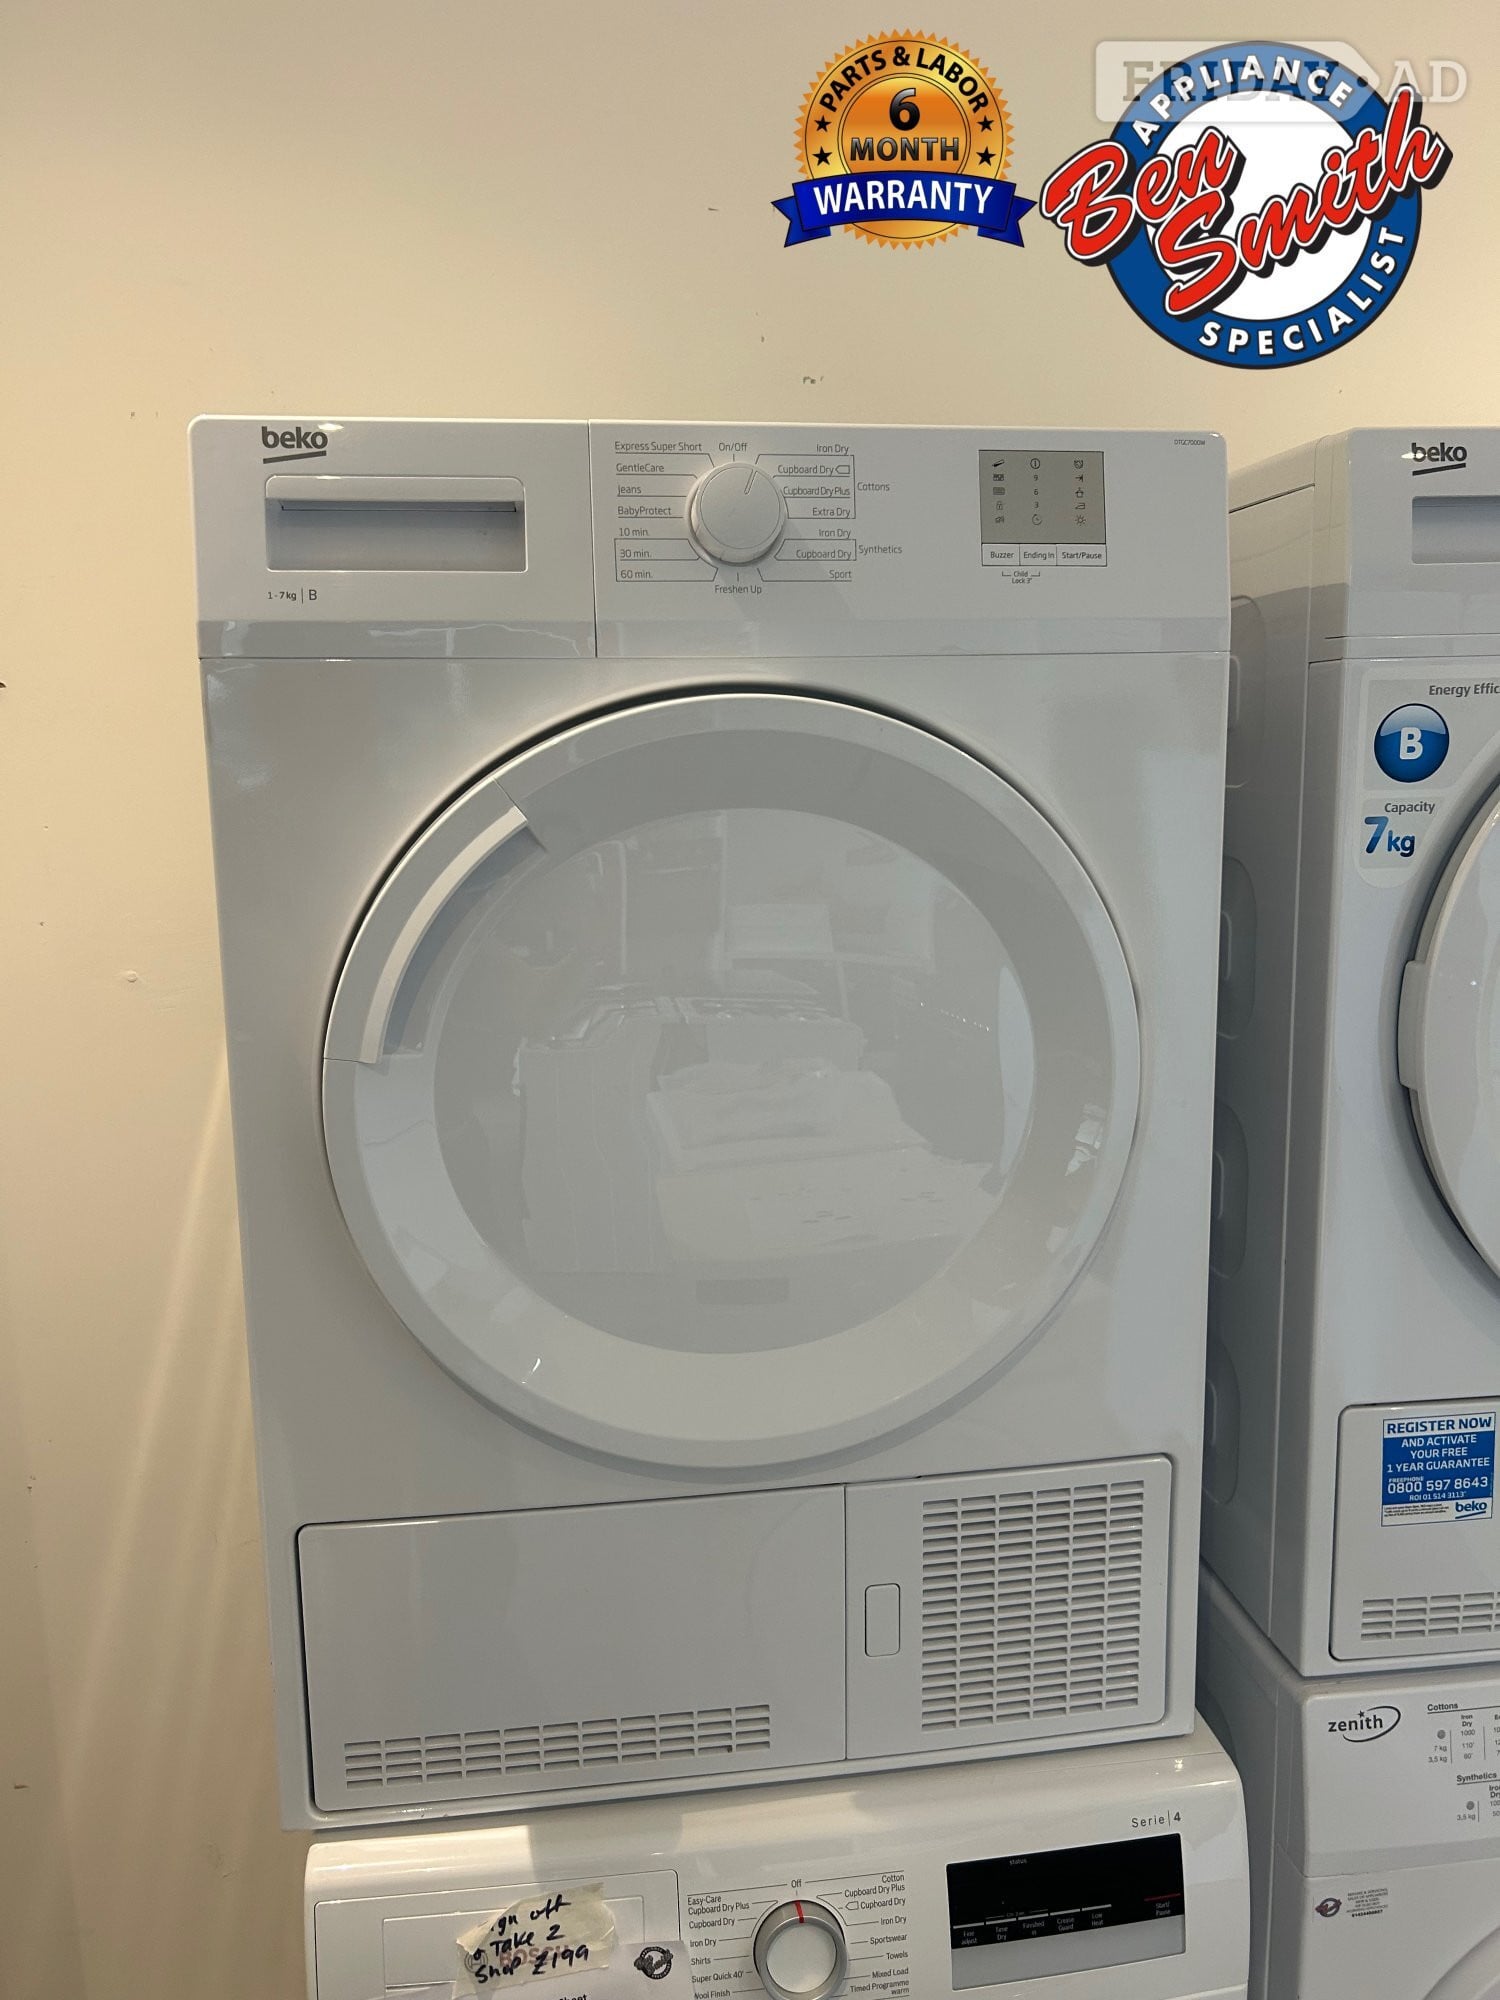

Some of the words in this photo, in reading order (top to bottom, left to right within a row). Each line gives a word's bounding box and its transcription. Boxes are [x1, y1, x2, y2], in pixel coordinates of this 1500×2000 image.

[262, 426, 328, 449] beko
[615, 441, 648, 452] Express
[650, 442, 676, 453] Super
[678, 442, 702, 452] Short
[718, 442, 748, 452] On/Off
[816, 444, 834, 453] Iron
[836, 444, 849, 456] Dry
[1411, 442, 1467, 462] beko
[616, 463, 664, 473] GentleCare
[777, 465, 818, 475] Cupboard
[819, 465, 835, 476] Dry
[617, 484, 641, 495] Jeans
[783, 486, 819, 496] Cupboard
[820, 486, 834, 497] Dry
[834, 486, 850, 496] Plus
[857, 482, 890, 492] Cottons
[617, 506, 671, 517] BabyProtect
[812, 507, 835, 517] Extra
[836, 507, 850, 519] Dry
[619, 527, 630, 537] 10
[632, 528, 649, 537] min.
[819, 529, 836, 537] Iron
[837, 529, 851, 540] Dry
[620, 549, 631, 558] 30
[633, 549, 651, 558] min.
[858, 544, 902, 555] Synthetics
[990, 551, 1014, 559] Buzzer
[796, 550, 835, 560] Cupboard
[837, 550, 851, 561] Dry
[1023, 551, 1047, 560] Ending
[1062, 551, 1102, 560] Start/Pause
[620, 569, 632, 579] 60
[634, 570, 653, 579] min.
[829, 569, 851, 580] Sport
[1013, 570, 1028, 578] Child
[309, 589, 318, 601] B
[715, 584, 748, 594] Freshen
[751, 585, 762, 597] Up
[1428, 685, 1470, 697] Energy
[1399, 726, 1423, 760] B
[1384, 801, 1435, 814] Capacity
[1387, 1419, 1455, 1434] REGISTER
[1459, 1417, 1492, 1429] NOW
[1401, 1437, 1424, 1448] AND
[1426, 1434, 1477, 1446] ACTIVATE
[1410, 1449, 1439, 1459] YOUR
[1442, 1447, 1468, 1457] FREE
[1387, 1464, 1393, 1473] 1
[1396, 1462, 1424, 1472] YEAR
[1426, 1457, 1490, 1470] GUARANTEE
[1387, 1481, 1422, 1494] 0800
[1426, 1479, 1451, 1491] 597
[1454, 1476, 1488, 1489] 8643
[1455, 1501, 1487, 1512] beko
[1427, 1703, 1458, 1711] Cottons
[1328, 1714, 1383, 1732] zenith
[1456, 1772, 1497, 1783] Synthetics
[1131, 1816, 1164, 1828] Serie
[1173, 1812, 1181, 1822] 4
[791, 1878, 802, 1888] Off
[881, 1874, 905, 1884] Cotton
[844, 1888, 877, 1898] Cupboard
[878, 1886, 890, 1896] Dry
[891, 1883, 905, 1892] Plus
[688, 1895, 721, 1906] Easy-Care
[860, 1899, 893, 1910] Cupboard
[894, 1897, 906, 1908] Dry
[530, 1894, 571, 1919] off
[688, 1905, 720, 1916] Cupboard
[722, 1904, 734, 1914] Dry
[735, 1902, 750, 1910] Plus
[689, 1919, 721, 1930] Cupboard
[723, 1918, 735, 1928] Dry
[880, 1917, 893, 1926] Iron
[894, 1915, 907, 1925] Dry
[546, 1924, 565, 1941] 2
[690, 1939, 703, 1948] Iron
[705, 1937, 717, 1947] Dry
[870, 1933, 907, 1946] Sportswear
[691, 1956, 711, 1966] Shirts
[886, 1951, 908, 1960] Towels
[691, 1974, 712, 1985] Super
[713, 1972, 733, 1983] Quick
[872, 1969, 891, 1979] Mixed
[893, 1967, 908, 1976] Load
[850, 1984, 870, 1993] Timed
[872, 1979, 909, 1990] Programme
[710, 1988, 731, 1998] Finish
[891, 1988, 909, 1996] warm
